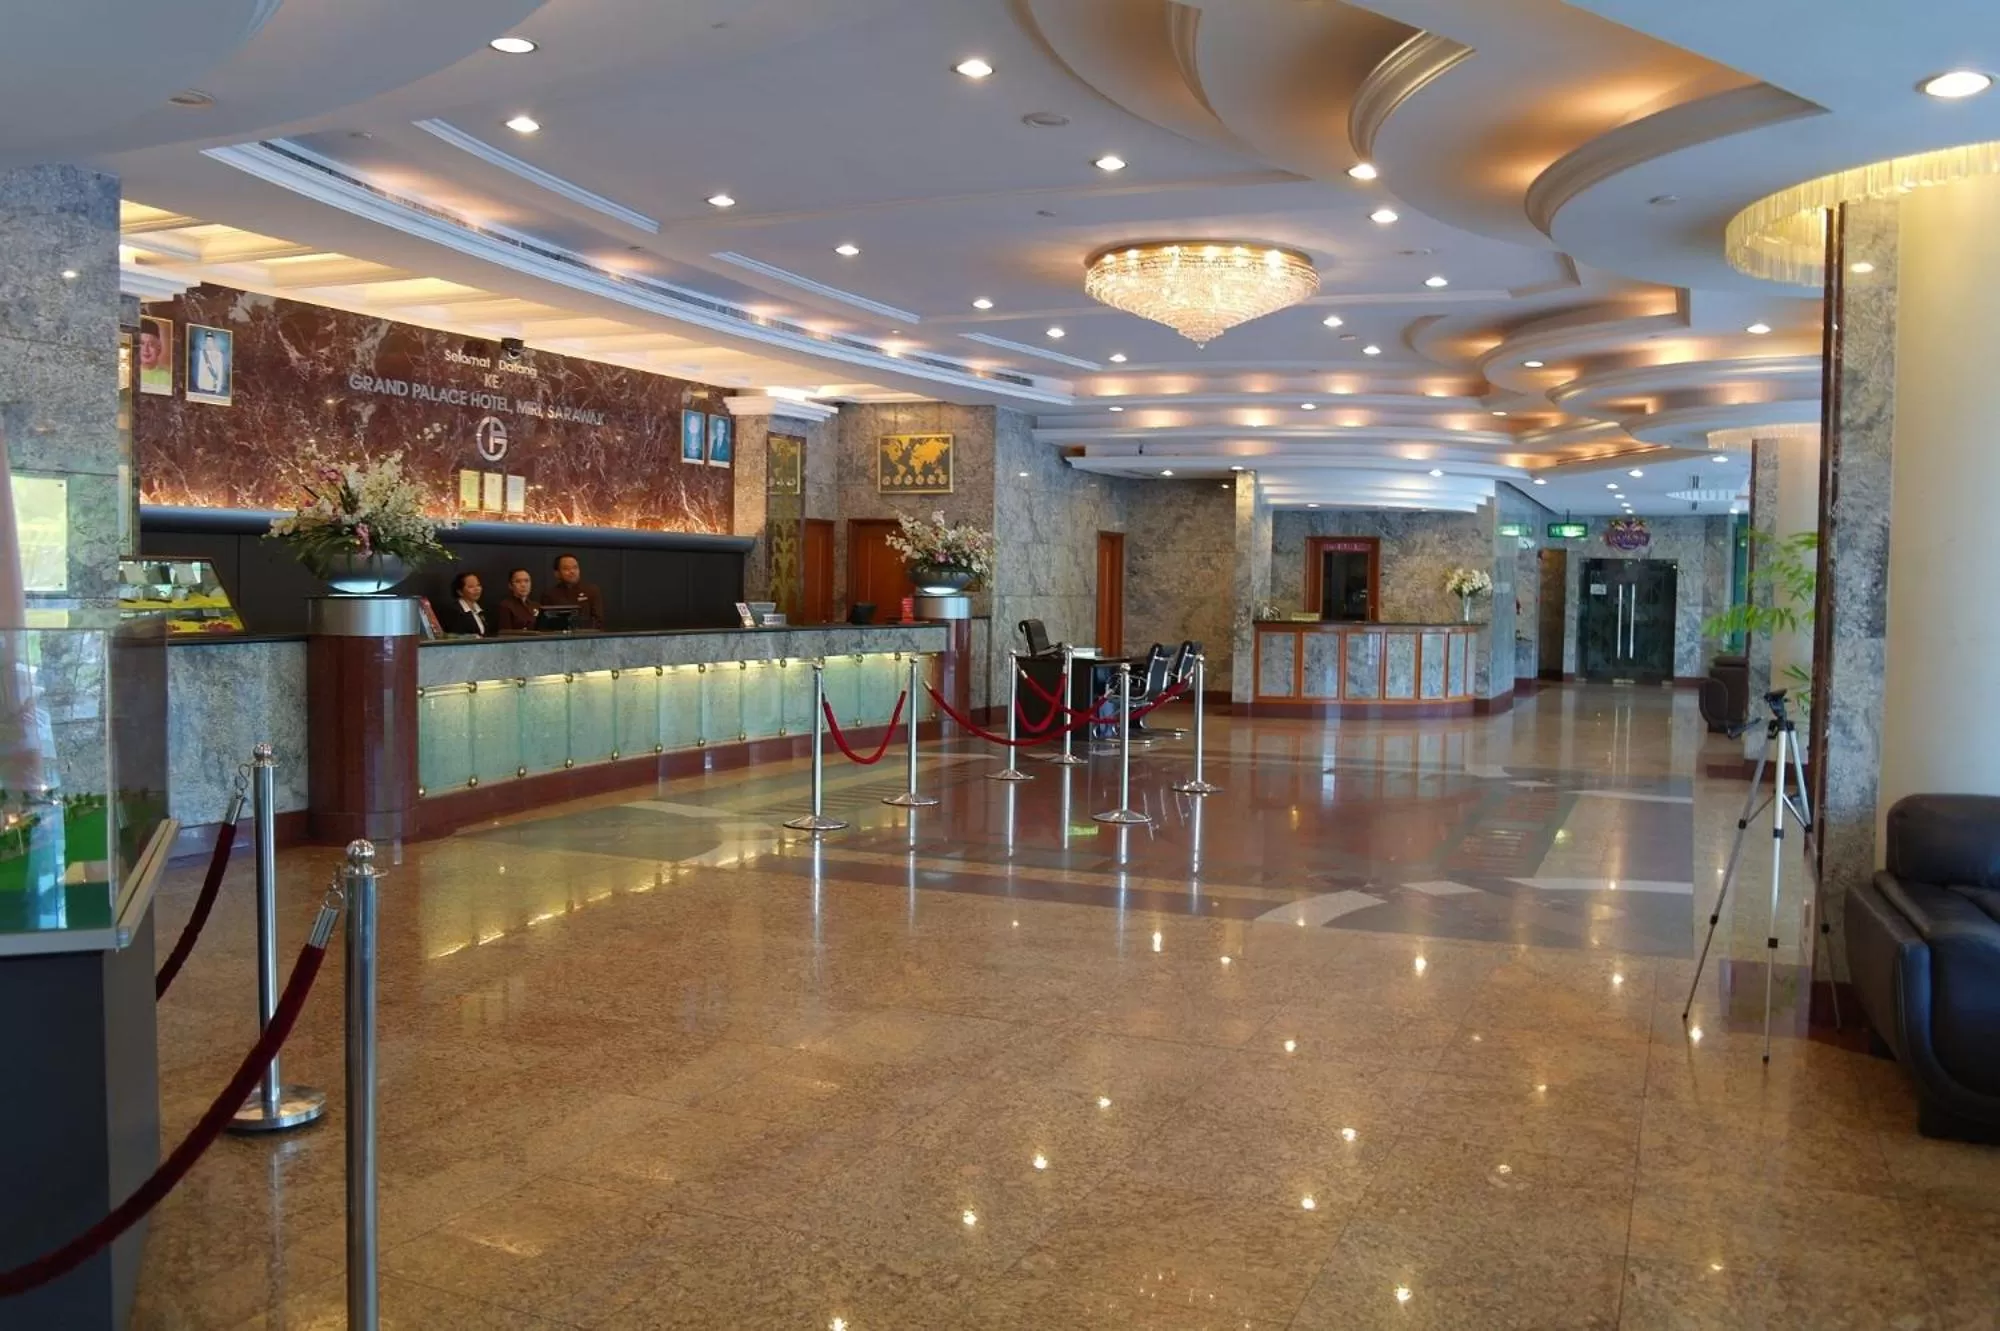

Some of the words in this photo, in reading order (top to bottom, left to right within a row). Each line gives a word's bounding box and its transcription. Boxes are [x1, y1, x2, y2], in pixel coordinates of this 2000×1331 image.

[444, 348, 490, 369] Selamat
[499, 359, 538, 378] Datang
[484, 373, 501, 389] KE
[348, 373, 408, 397] GRAND
[412, 383, 467, 406] PALACE
[470, 391, 513, 415] HOTEL,
[547, 404, 605, 426] SARAWAK
